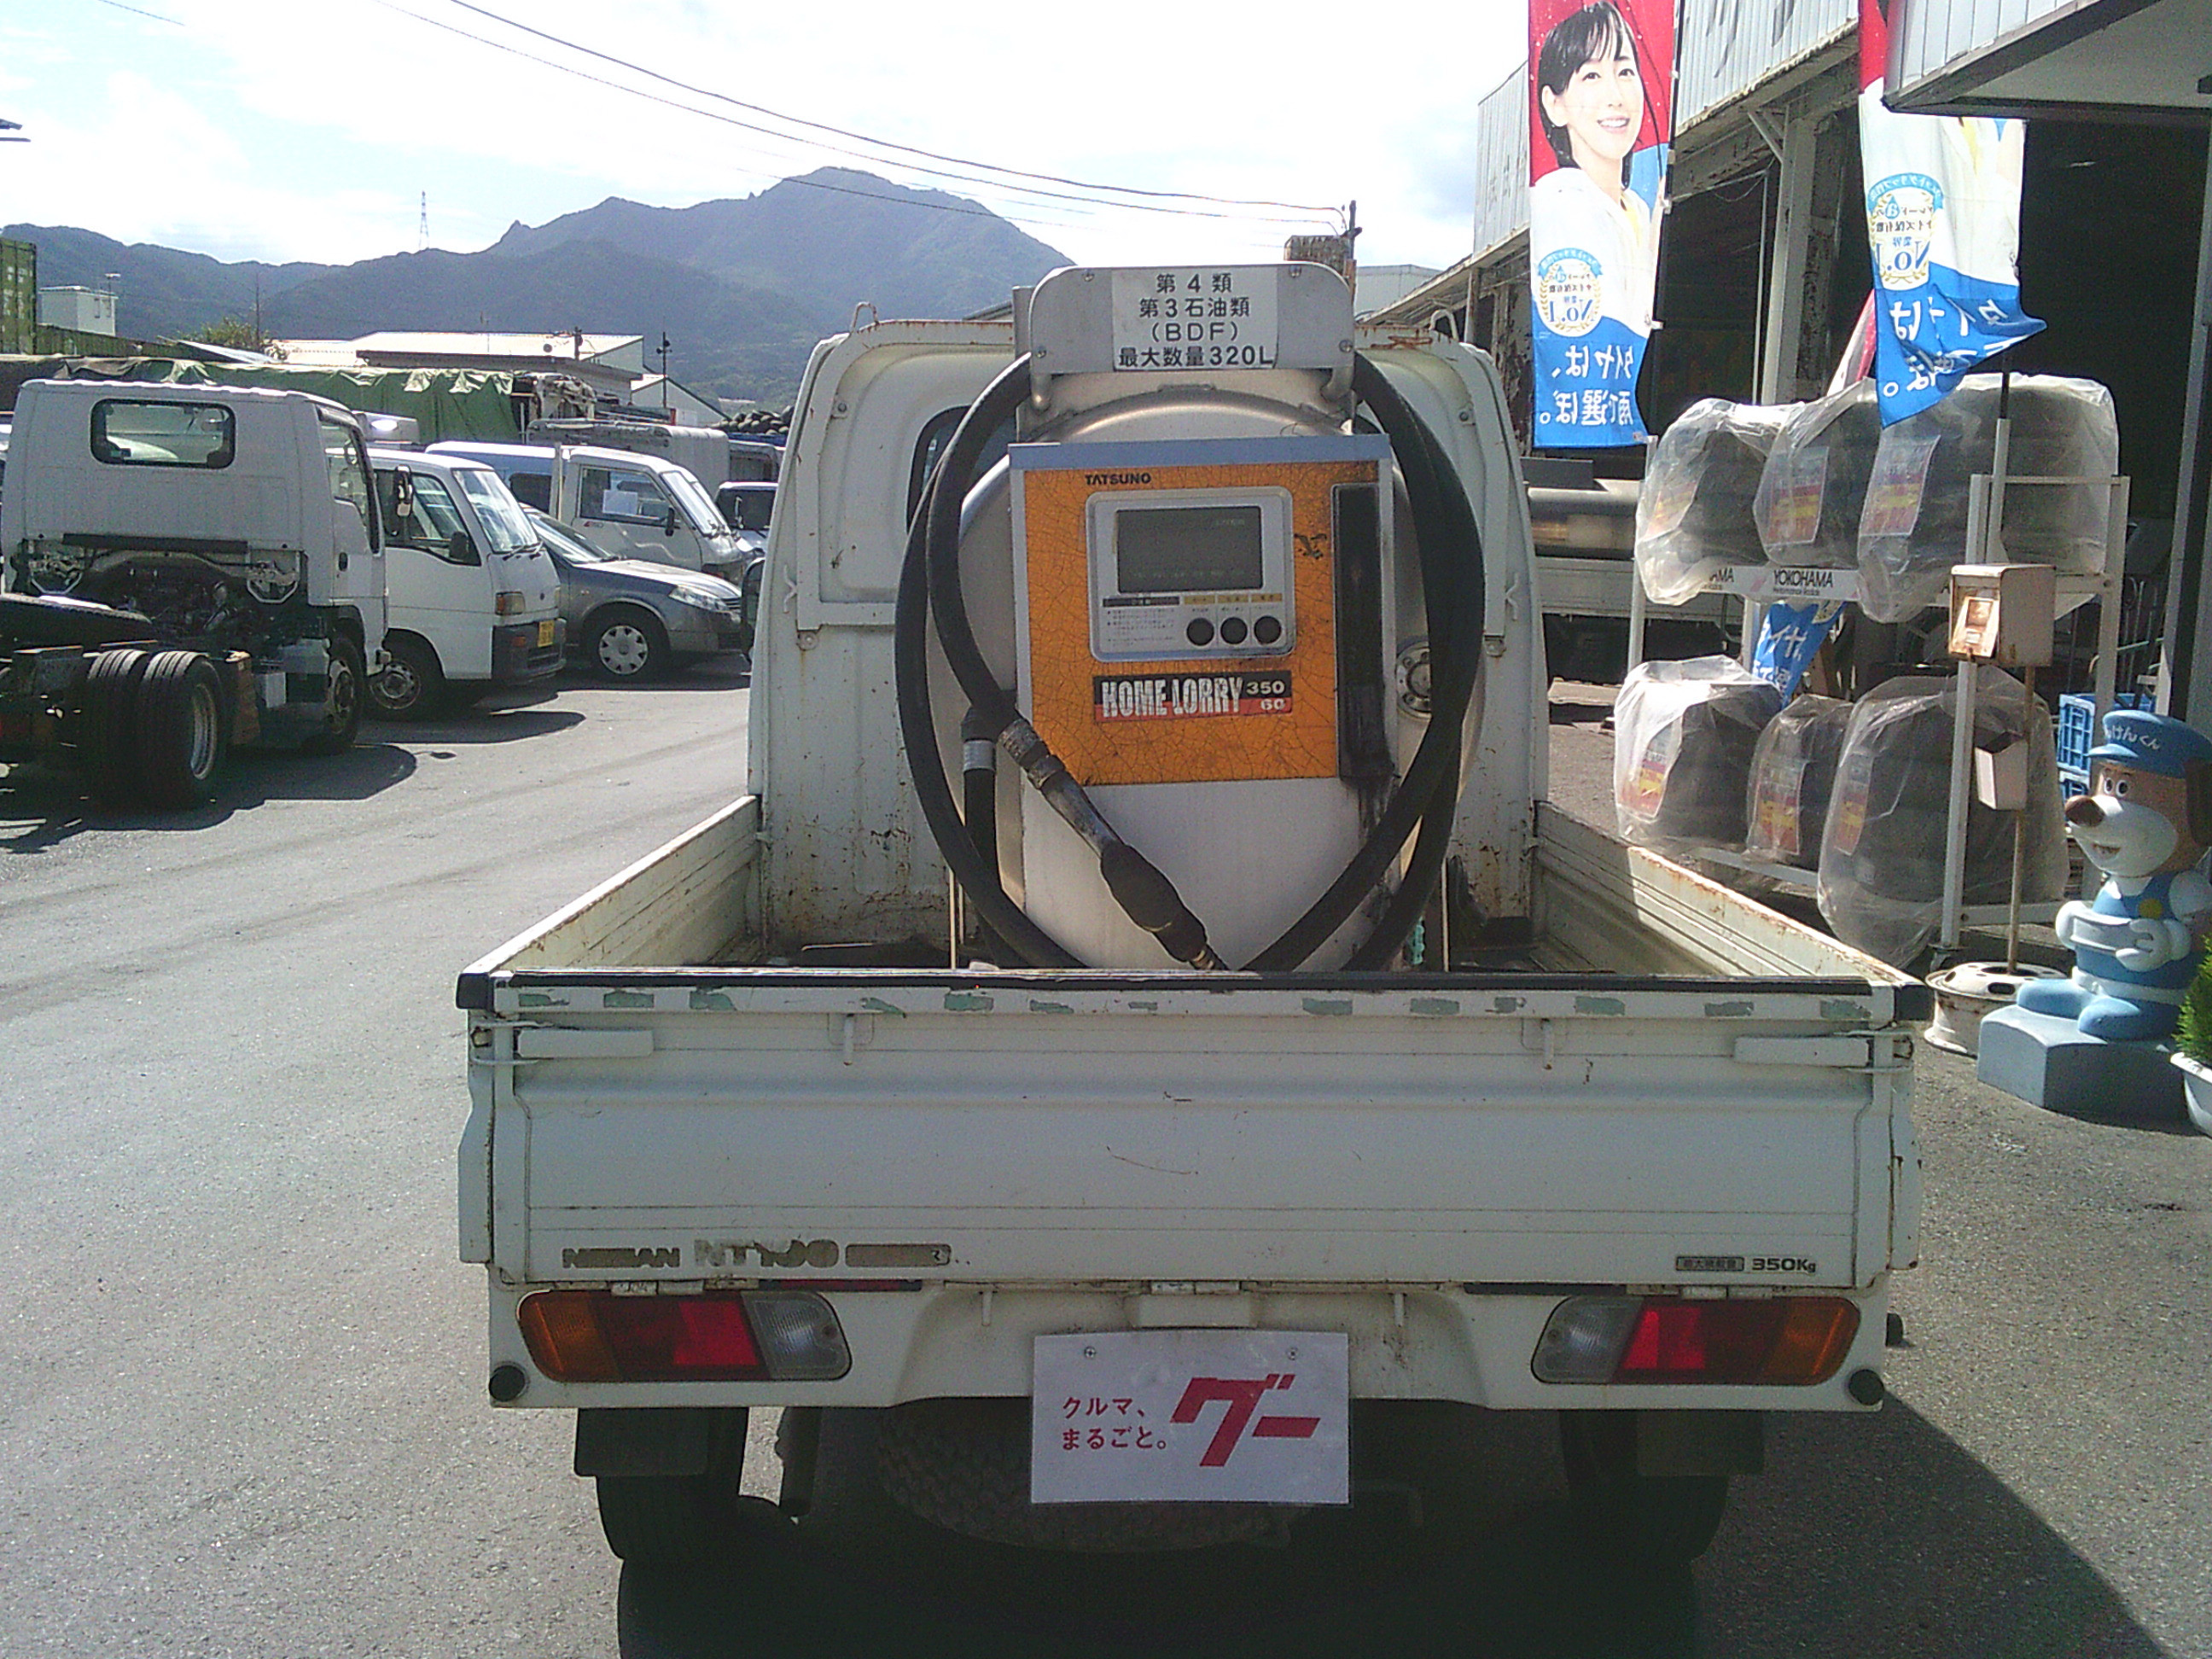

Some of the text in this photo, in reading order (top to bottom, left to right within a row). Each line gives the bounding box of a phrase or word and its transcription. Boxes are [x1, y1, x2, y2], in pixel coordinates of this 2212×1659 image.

[1139, 297, 1249, 317] 第3石油類
[1152, 322, 1238, 342] (BDF)
[1085, 473, 1151, 485] TATSUNO
[1774, 569, 1833, 587] YOKOHAMA
[1102, 677, 1284, 718] HOME LORRY 350
[1260, 698, 1285, 710] 60
[562, 1248, 680, 1268] NAN
[1752, 1258, 1816, 1273] 350Kg
[1062, 1396, 1146, 1418] クルマ、
[1169, 1373, 1321, 1467] グー
[1062, 1426, 1167, 1450] まるごと。
